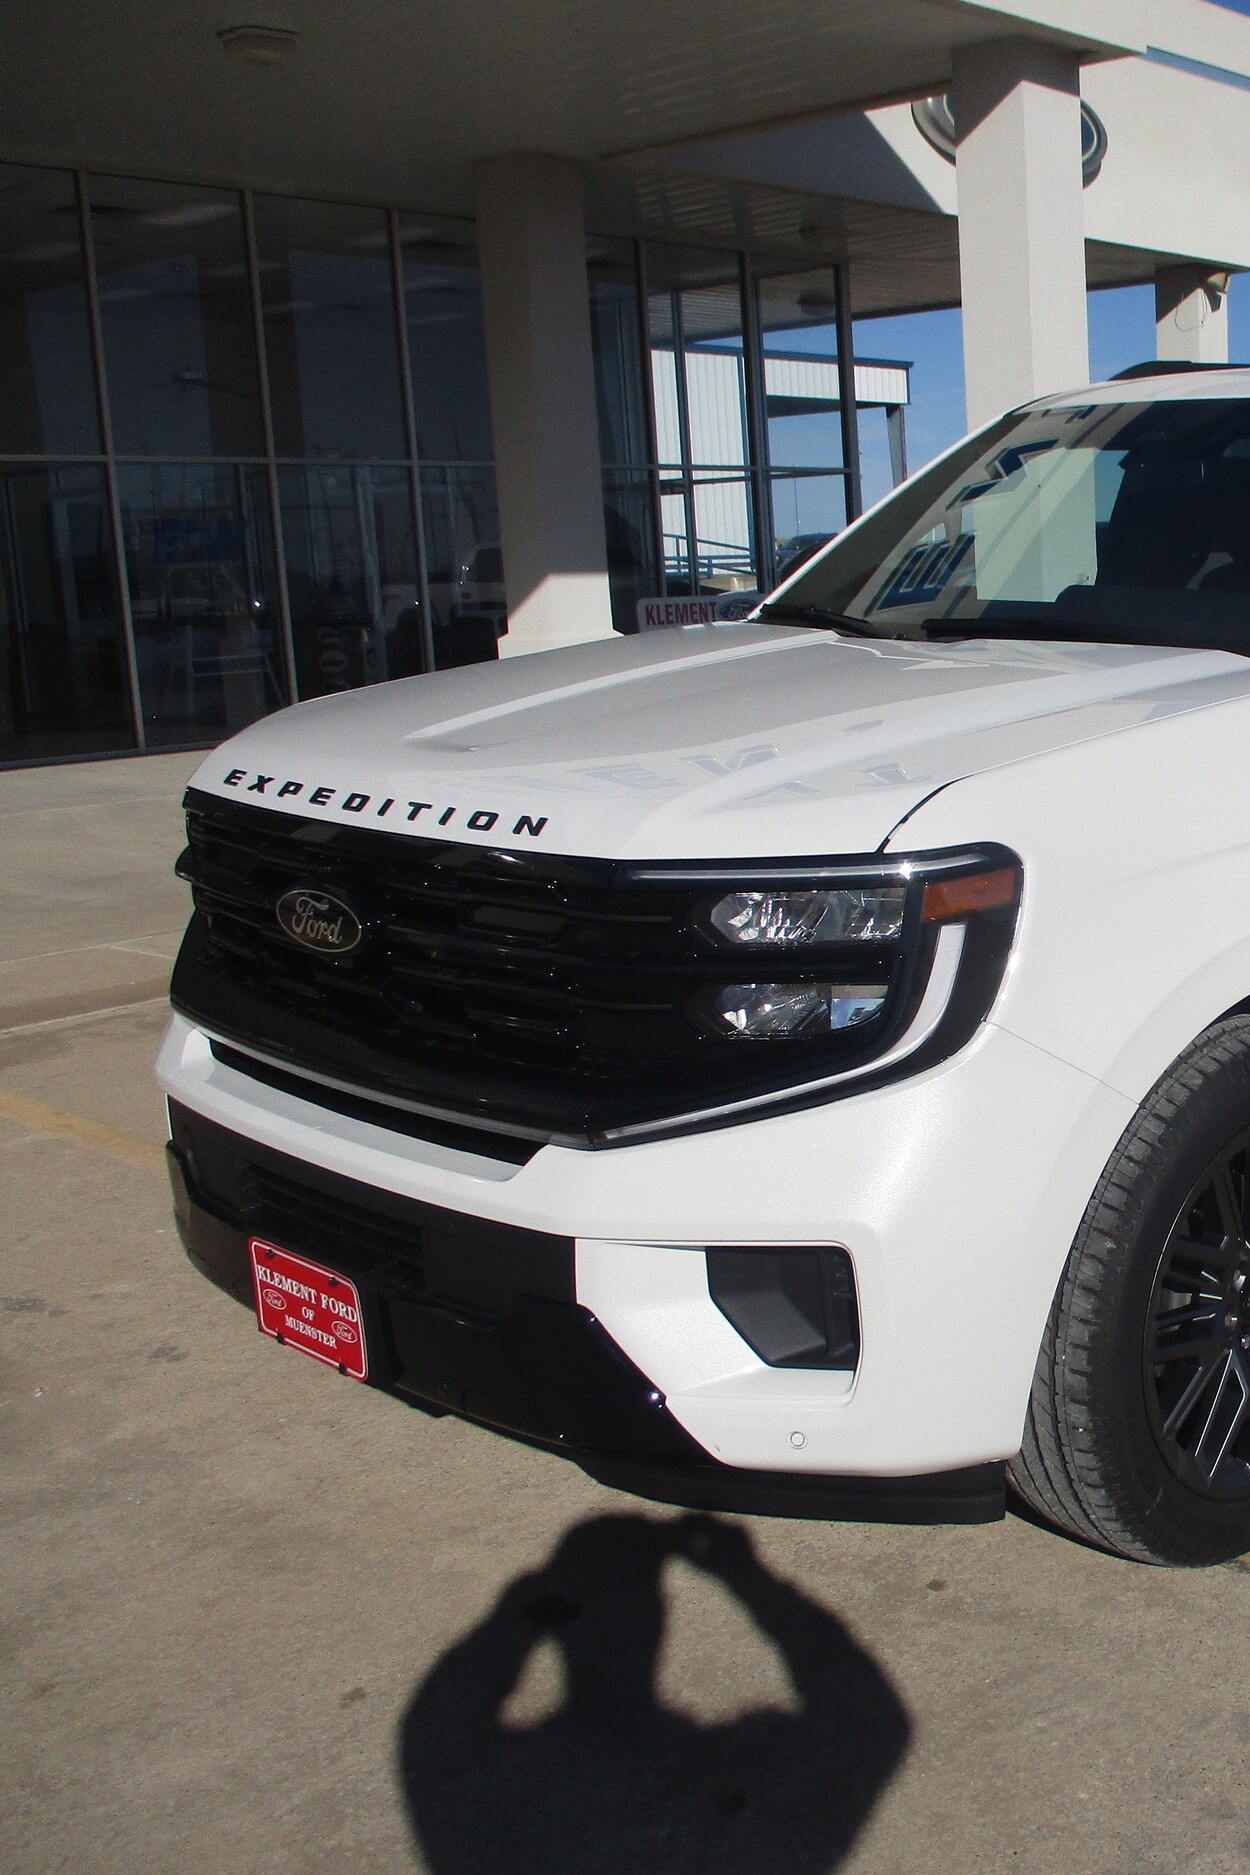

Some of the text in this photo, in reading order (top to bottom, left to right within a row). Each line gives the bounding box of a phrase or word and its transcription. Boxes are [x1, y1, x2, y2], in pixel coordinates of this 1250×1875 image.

[645, 602, 717, 625] KLEMENT
[223, 769, 549, 837] EXPEDITION
[291, 896, 344, 944] Ford
[256, 1265, 358, 1323] KLEMENT FORD
[302, 1306, 315, 1322] OF
[285, 1315, 338, 1350] MUENSTER
